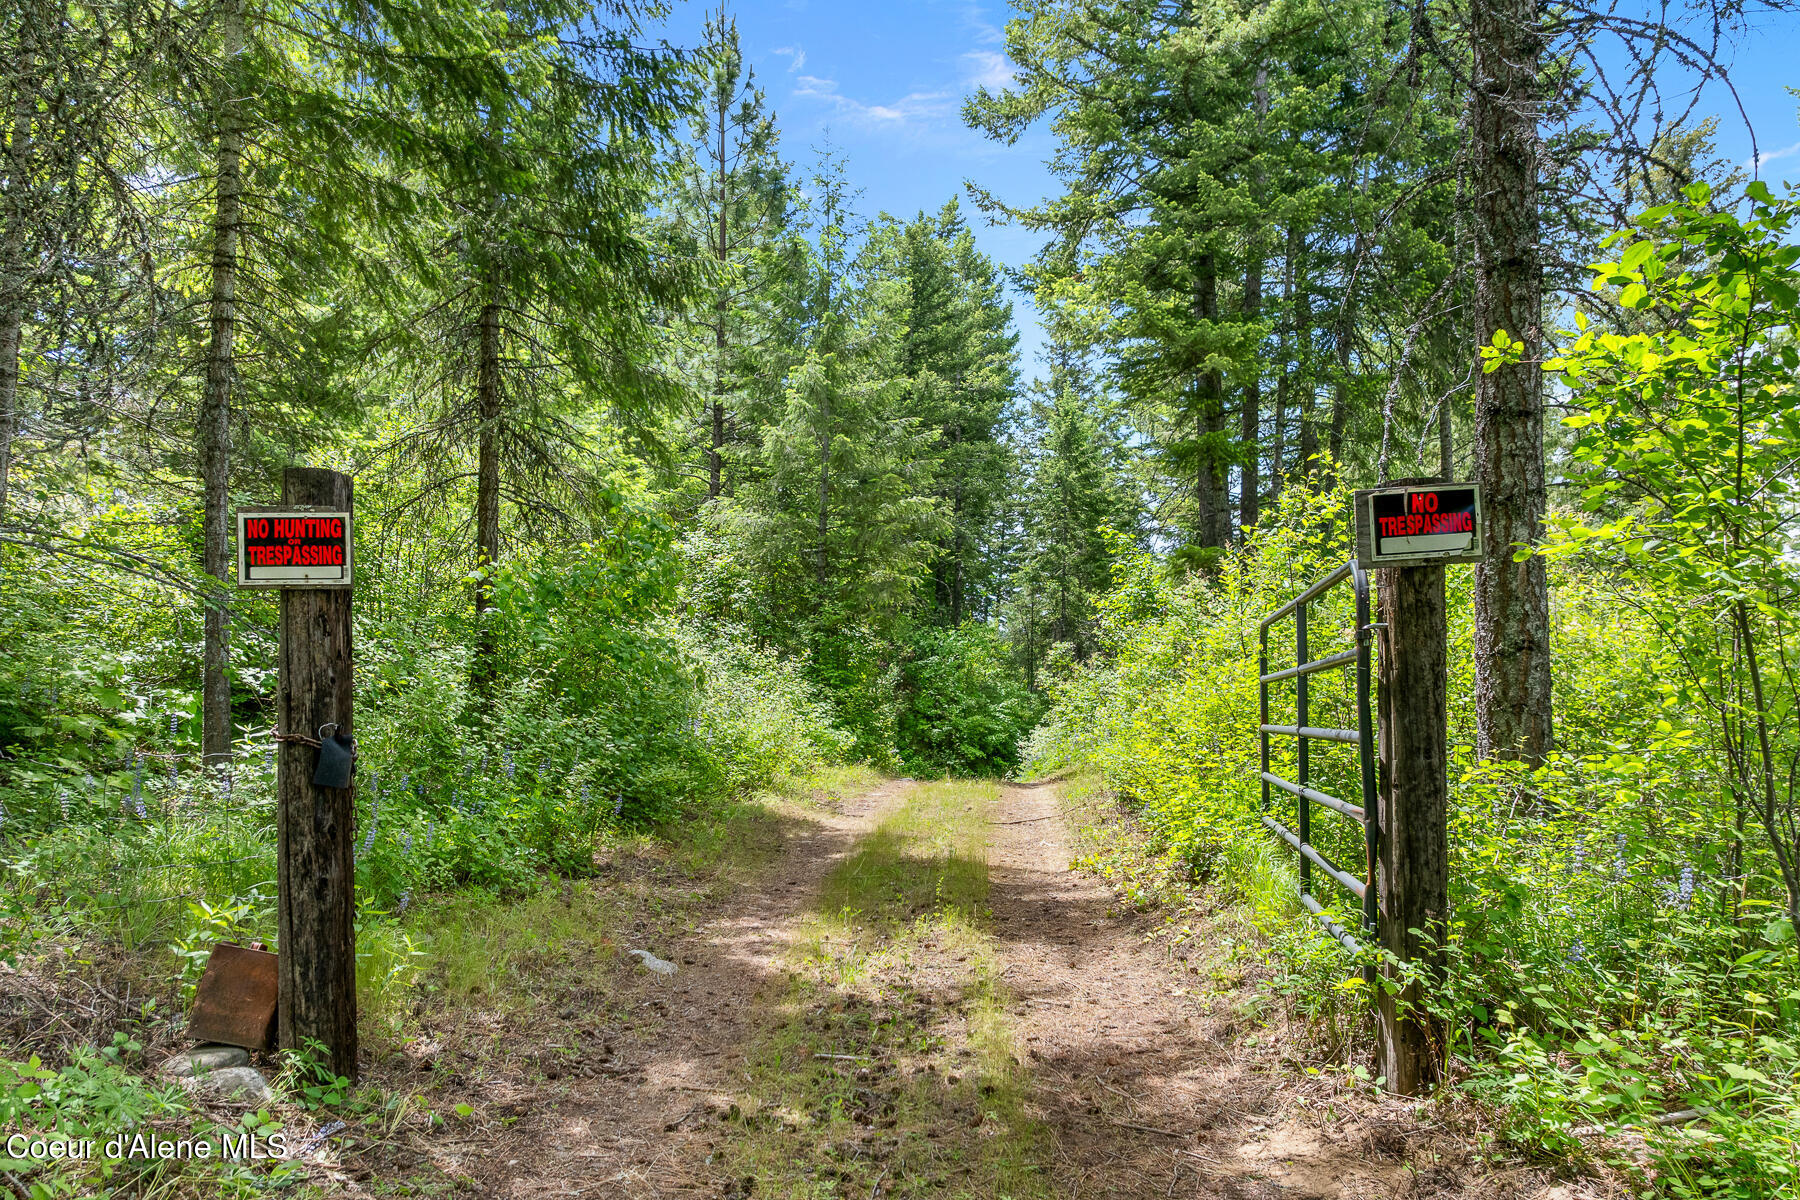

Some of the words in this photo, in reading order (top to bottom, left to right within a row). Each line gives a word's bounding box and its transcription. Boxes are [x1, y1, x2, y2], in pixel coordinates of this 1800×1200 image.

[1411, 492, 1439, 514] NO
[247, 518, 269, 539] NO
[274, 518, 342, 539] HUNTING
[1379, 511, 1473, 537] TRESPASSING
[247, 545, 343, 566] TRESPASSING
